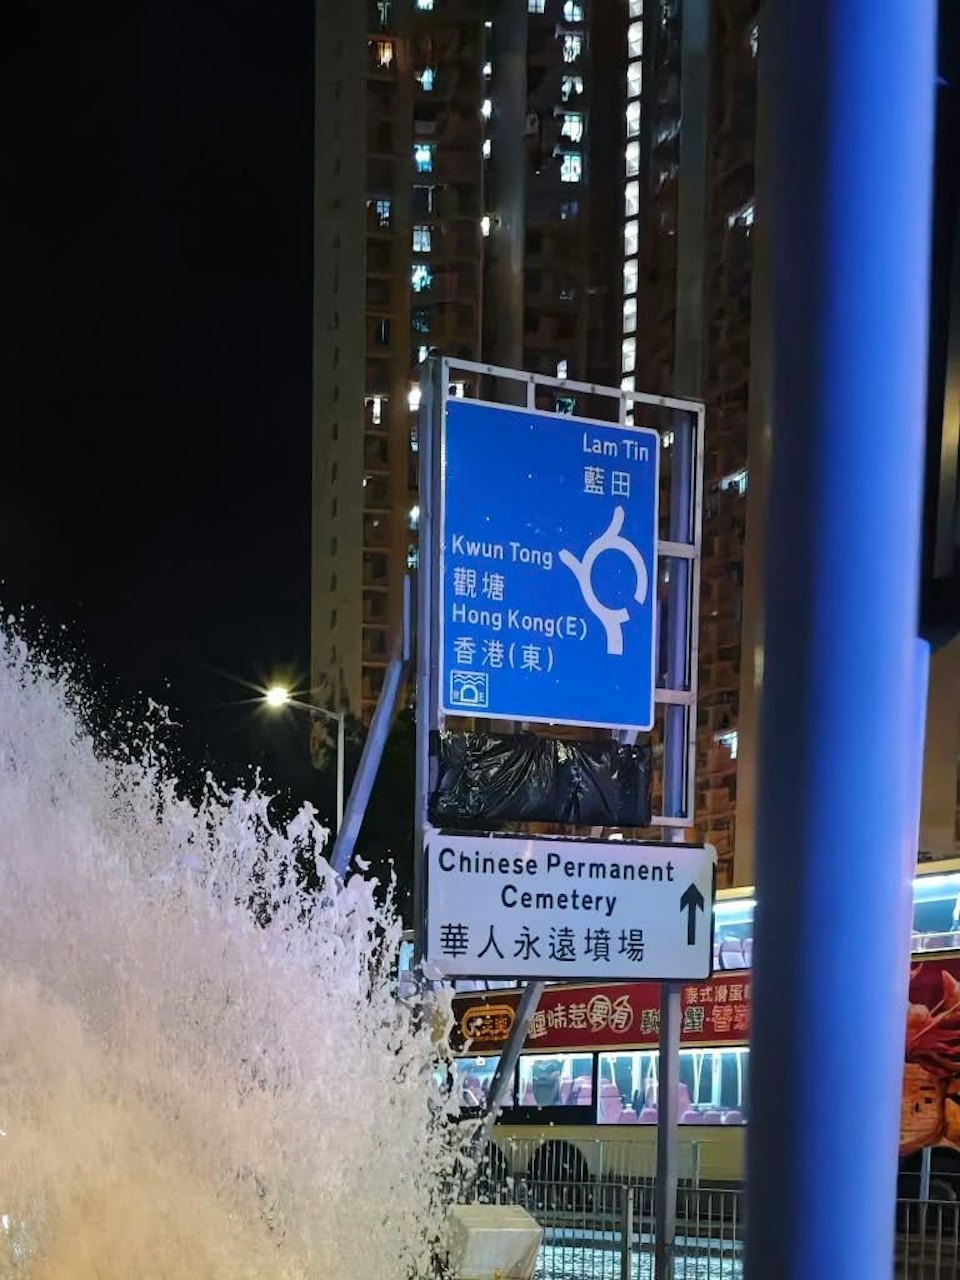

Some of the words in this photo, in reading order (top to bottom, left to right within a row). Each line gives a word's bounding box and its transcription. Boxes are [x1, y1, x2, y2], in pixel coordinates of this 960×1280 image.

[582, 432, 618, 457] Lam
[620, 439, 649, 462] Tin
[582, 465, 631, 499] 藍田
[452, 534, 504, 561] Kwun
[509, 541, 553, 571] Tong
[452, 566, 505, 602] 觀塘
[452, 603, 503, 630] Hong
[438, 847, 538, 875] Chinese
[546, 852, 675, 882] Permanent
[501, 884, 617, 917] Cemetery
[440, 922, 646, 963] 華人永遠墳場
